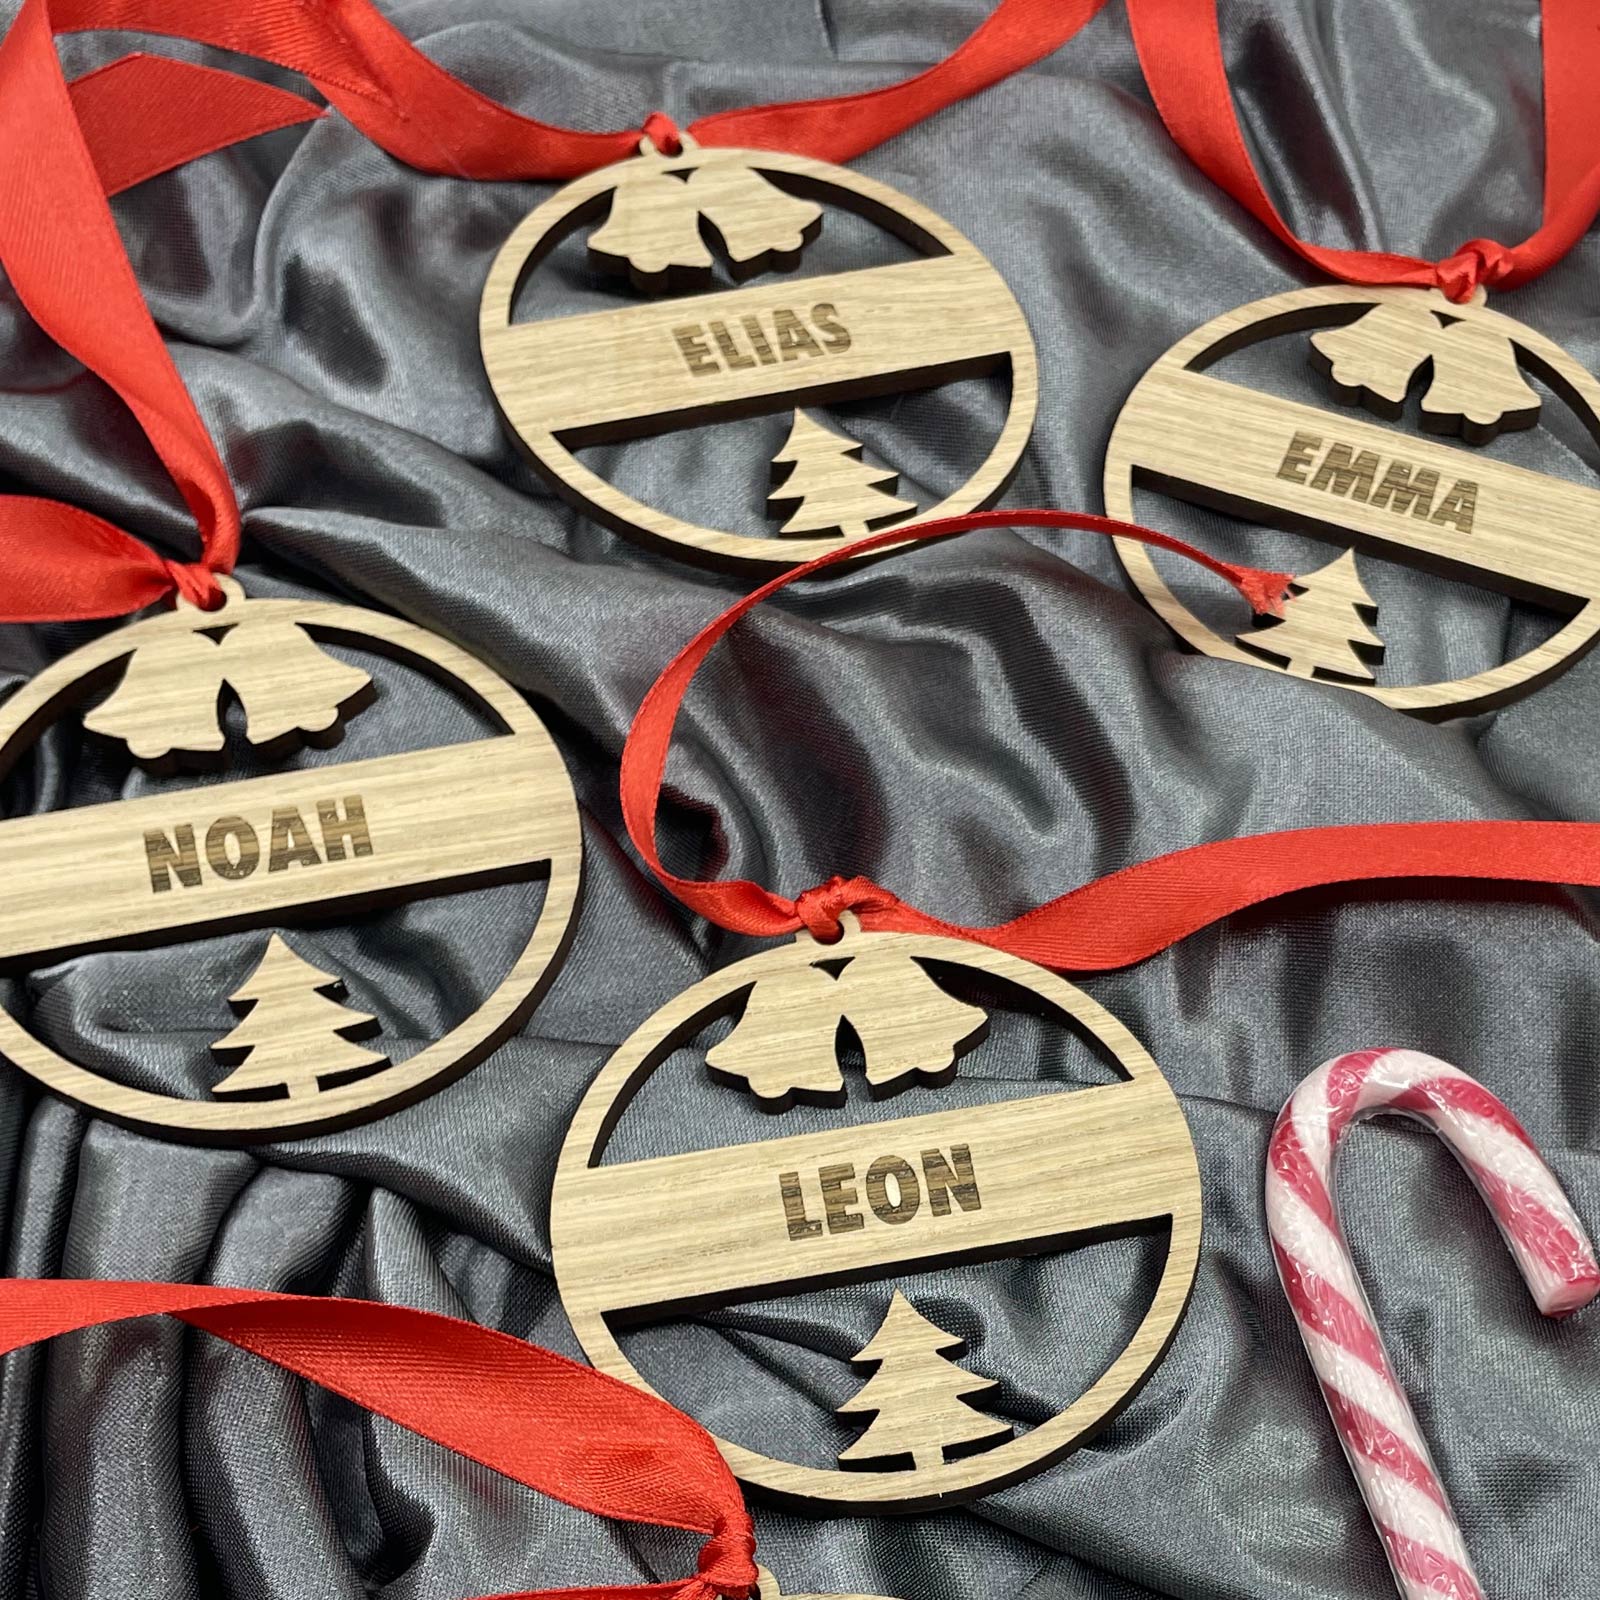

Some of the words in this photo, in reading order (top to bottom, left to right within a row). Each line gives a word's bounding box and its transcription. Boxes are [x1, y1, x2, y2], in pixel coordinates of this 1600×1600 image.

[671, 303, 851, 377] ELIAS
[1276, 431, 1479, 534] EMMA
[143, 794, 373, 893] NOAH
[779, 1143, 982, 1241] LEON
